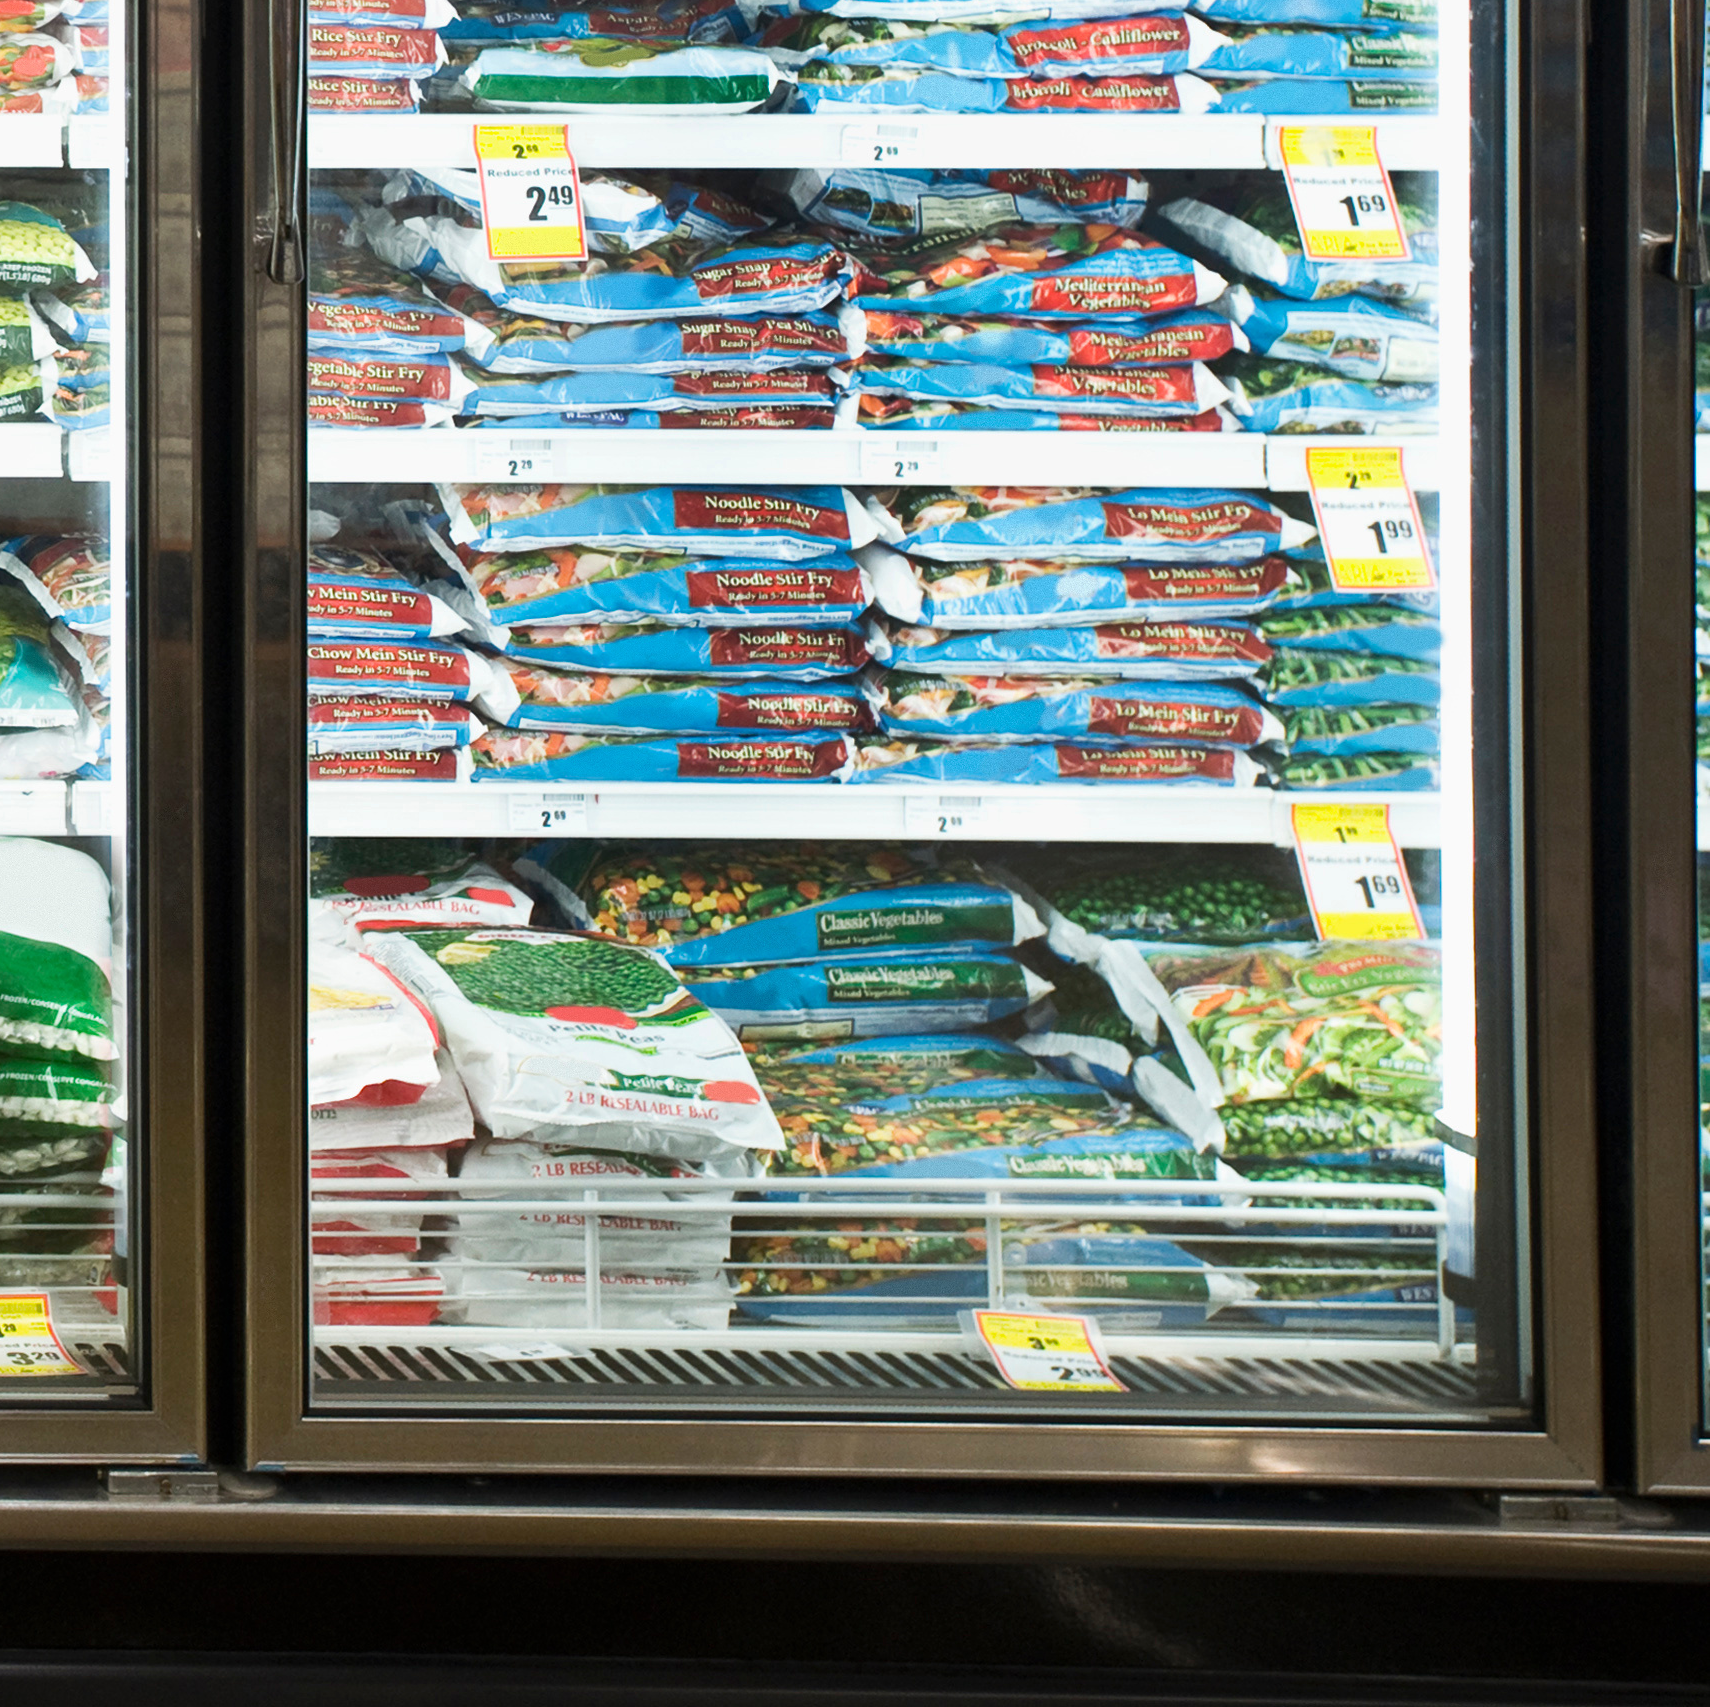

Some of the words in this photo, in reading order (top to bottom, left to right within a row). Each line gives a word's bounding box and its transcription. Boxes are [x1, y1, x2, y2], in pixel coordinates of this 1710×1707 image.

[312, 30, 345, 44] Rice
[350, 31, 373, 45] Stir
[1017, 37, 1077, 56] Broccoli
[1090, 27, 1180, 46] Cauliflower
[1082, 83, 1170, 98] Cauliflower
[1055, 278, 1166, 295] Mediterranean
[1069, 293, 1151, 310] Vegetables
[716, 573, 772, 588] Noodle
[775, 574, 802, 588] Stir
[308, 647, 352, 661] Chow
[356, 648, 391, 662] Mein
[395, 649, 421, 663] Stir
[600, 1095, 684, 1118] RESEALABLE
